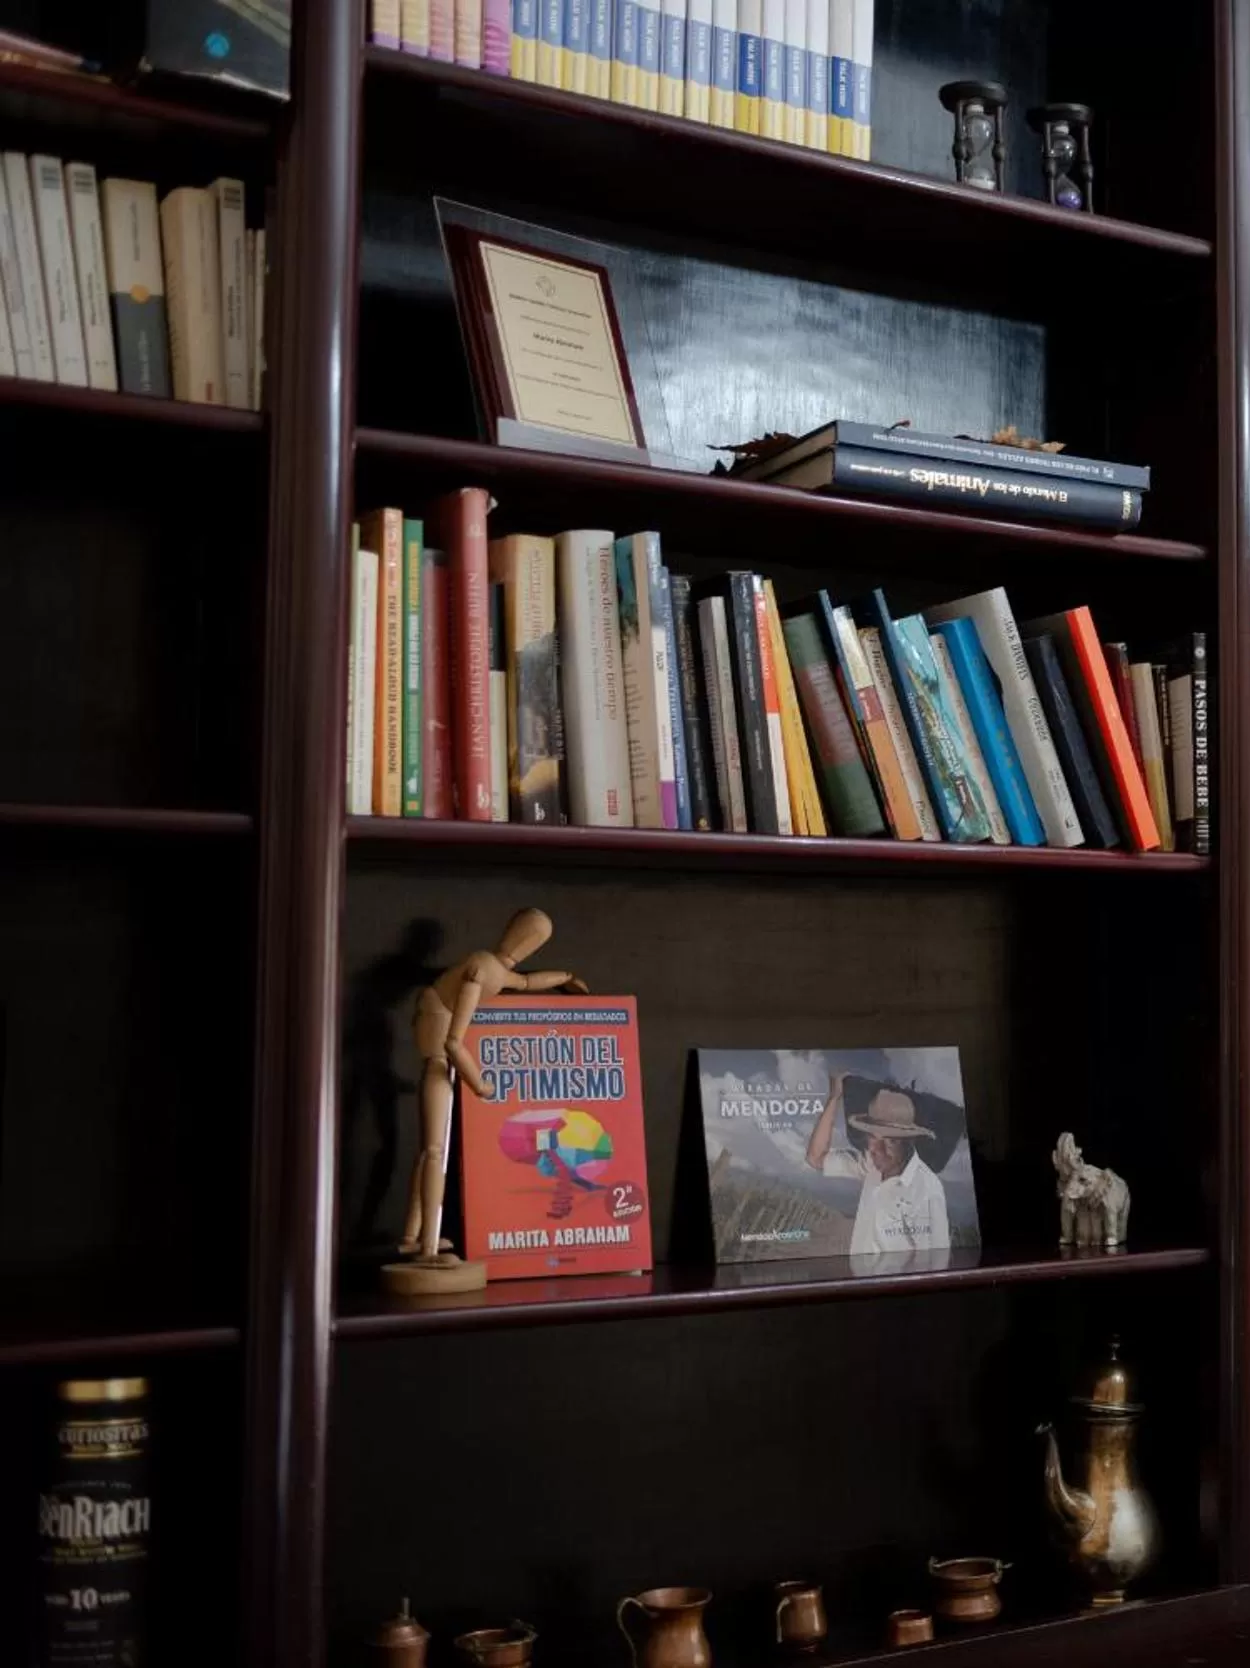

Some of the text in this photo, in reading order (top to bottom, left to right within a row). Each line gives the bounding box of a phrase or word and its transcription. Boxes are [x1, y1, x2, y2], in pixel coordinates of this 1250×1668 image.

[910, 468, 991, 497] Animales
[993, 482, 1009, 495] los
[1010, 484, 1022, 496] de
[1023, 486, 1058, 502] Mundo
[1194, 678, 1207, 730] PASOS
[1194, 736, 1208, 758] DE
[479, 1030, 624, 1066] GESTIÓN DEL
[481, 1067, 625, 1102] OPTIMISMO
[721, 1098, 825, 1117] MENDOZA
[488, 1224, 630, 1250] MARITA ABRAHAM
[70, 1588, 98, 1610] 10
